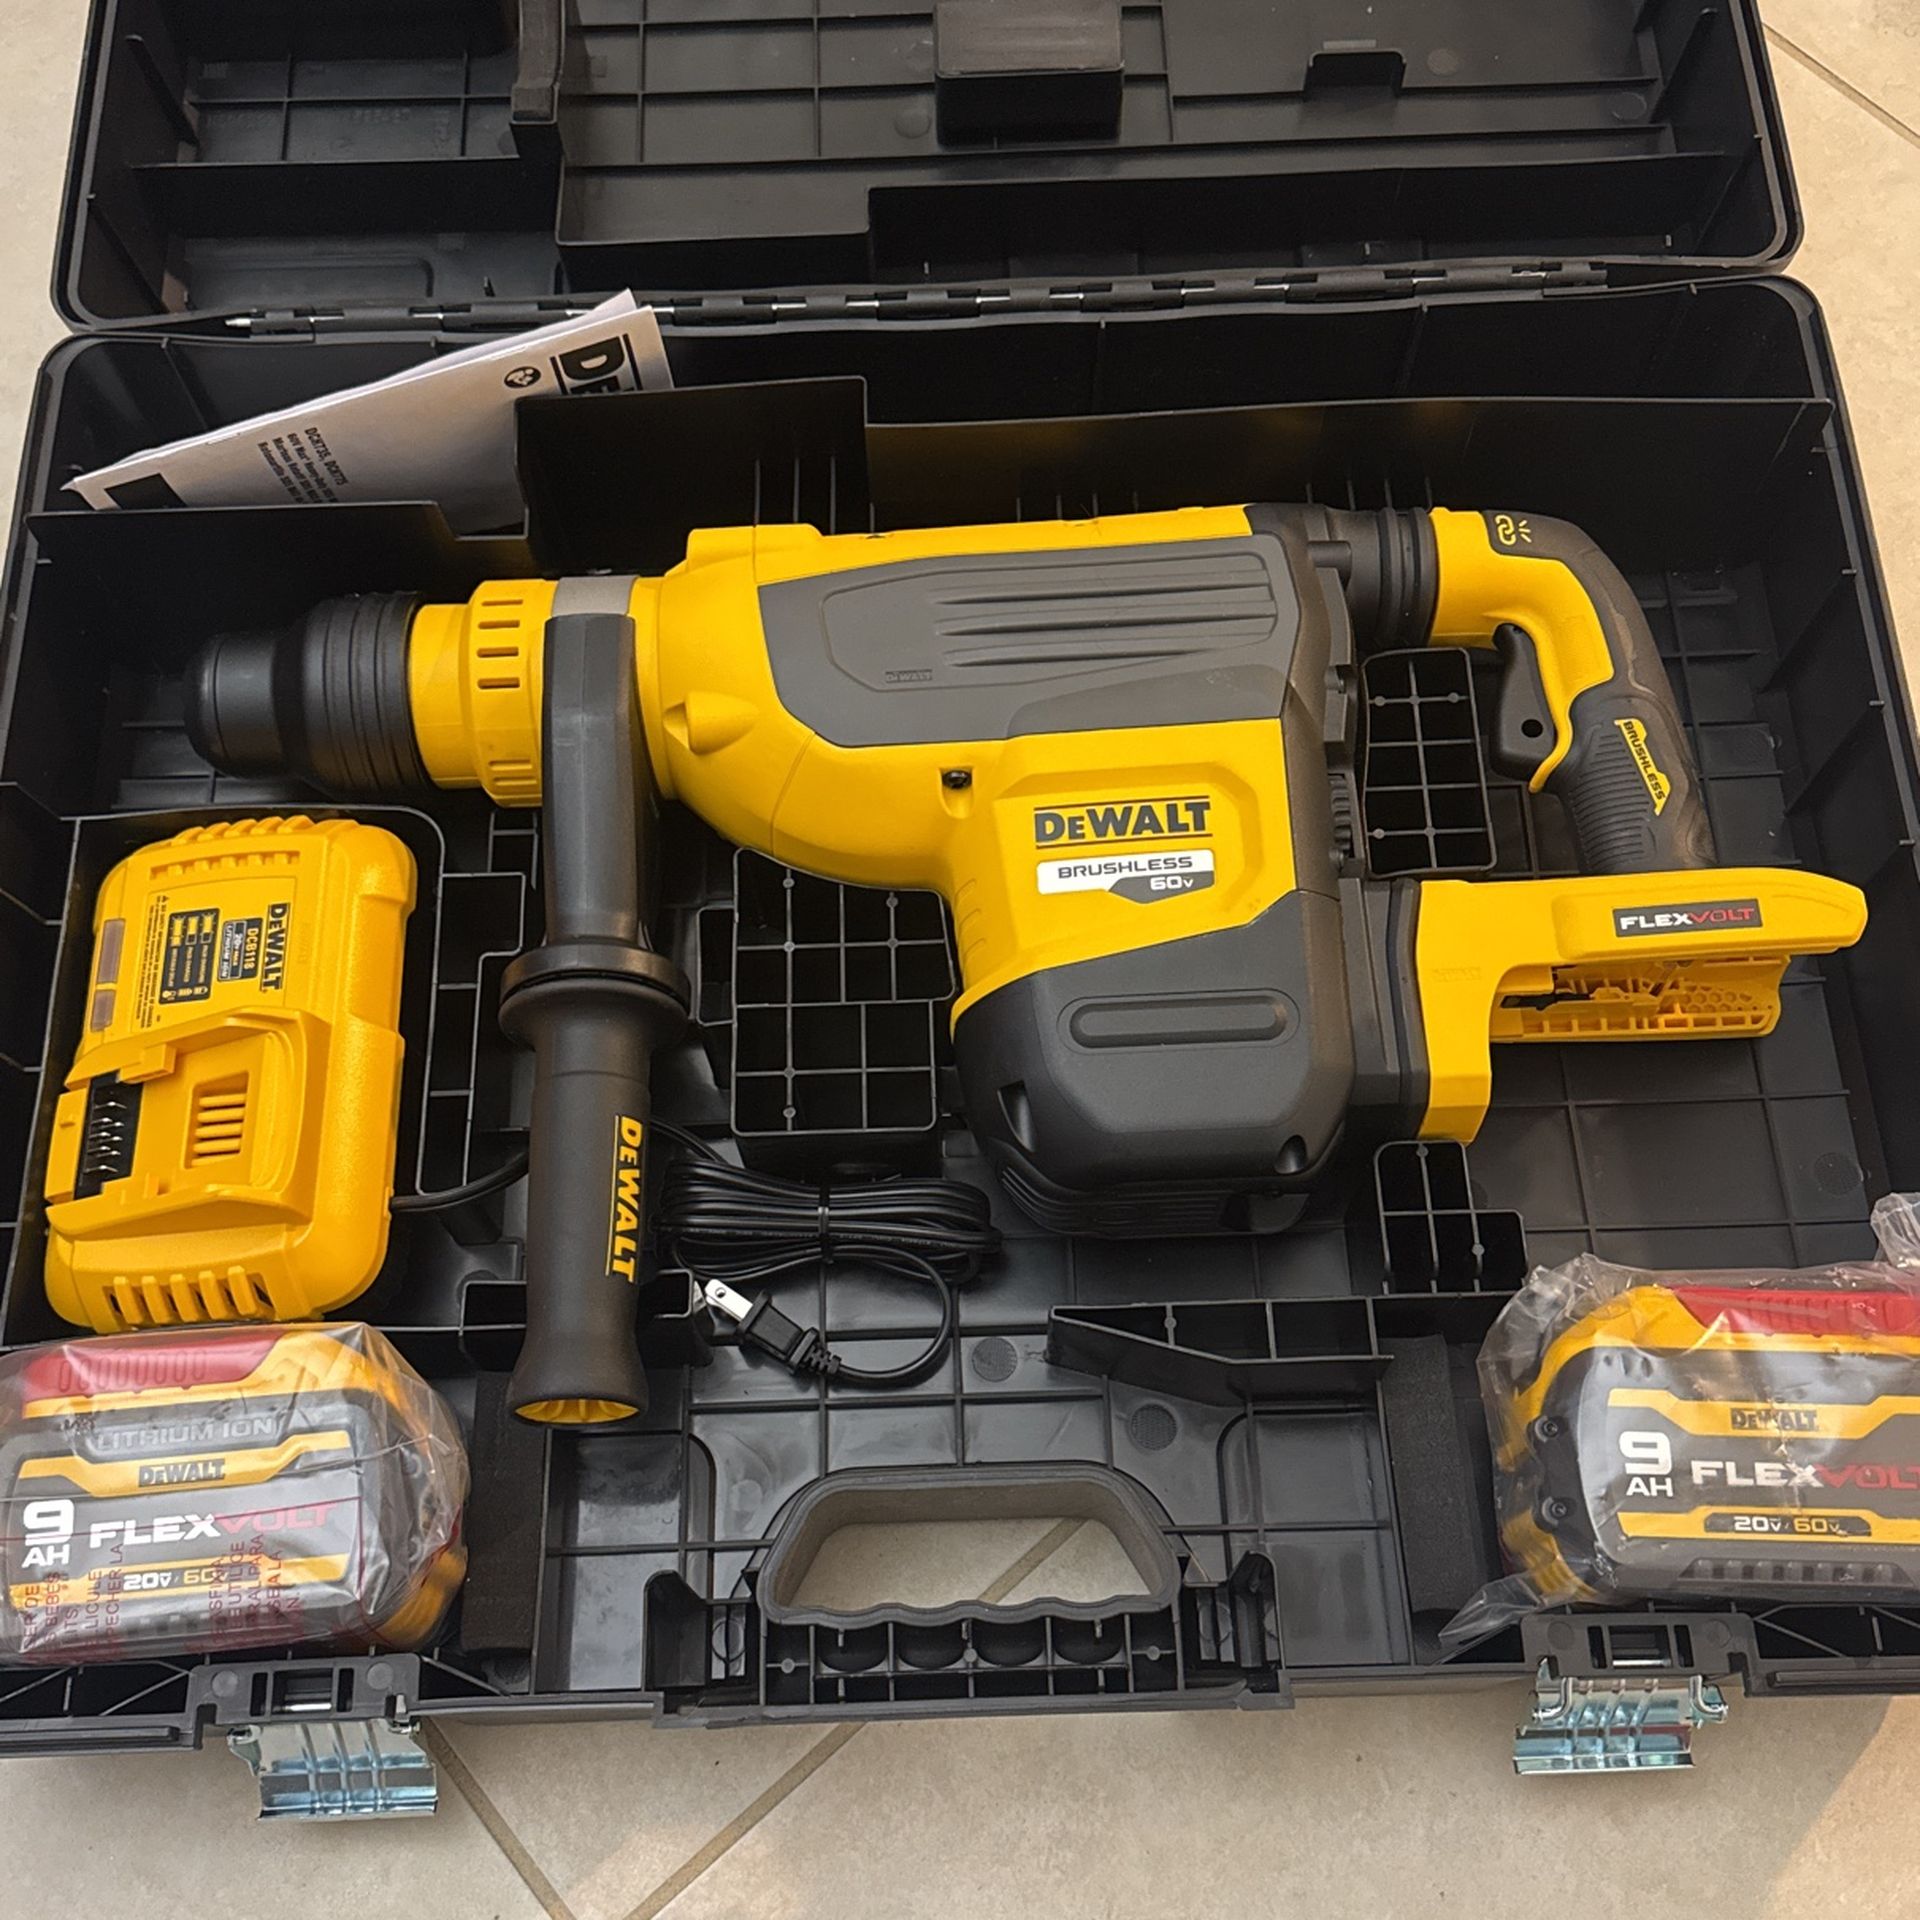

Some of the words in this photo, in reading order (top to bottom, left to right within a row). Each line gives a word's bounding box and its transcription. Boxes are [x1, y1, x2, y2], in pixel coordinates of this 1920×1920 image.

[1623, 720, 1666, 801] BRUSHLESS
[1034, 801, 1211, 844] DEWALT
[1058, 856, 1193, 879] BRUSHLESS
[1620, 908, 1755, 930] FLEXVOLT
[244, 928, 259, 969] DCB118
[262, 903, 288, 990] DEWALT
[612, 1115, 642, 1283] DEWALT
[97, 1423, 214, 1449] LITHIUM
[223, 1417, 272, 1438] ION
[1619, 1431, 1672, 1476] 9
[139, 1458, 225, 1487] DEWALT
[1626, 1477, 1673, 1497] AH
[23, 1499, 74, 1546] 9
[90, 1502, 338, 1549] FLEXVOLT
[21, 1543, 70, 1568] AH
[109, 1543, 123, 1564] LA
